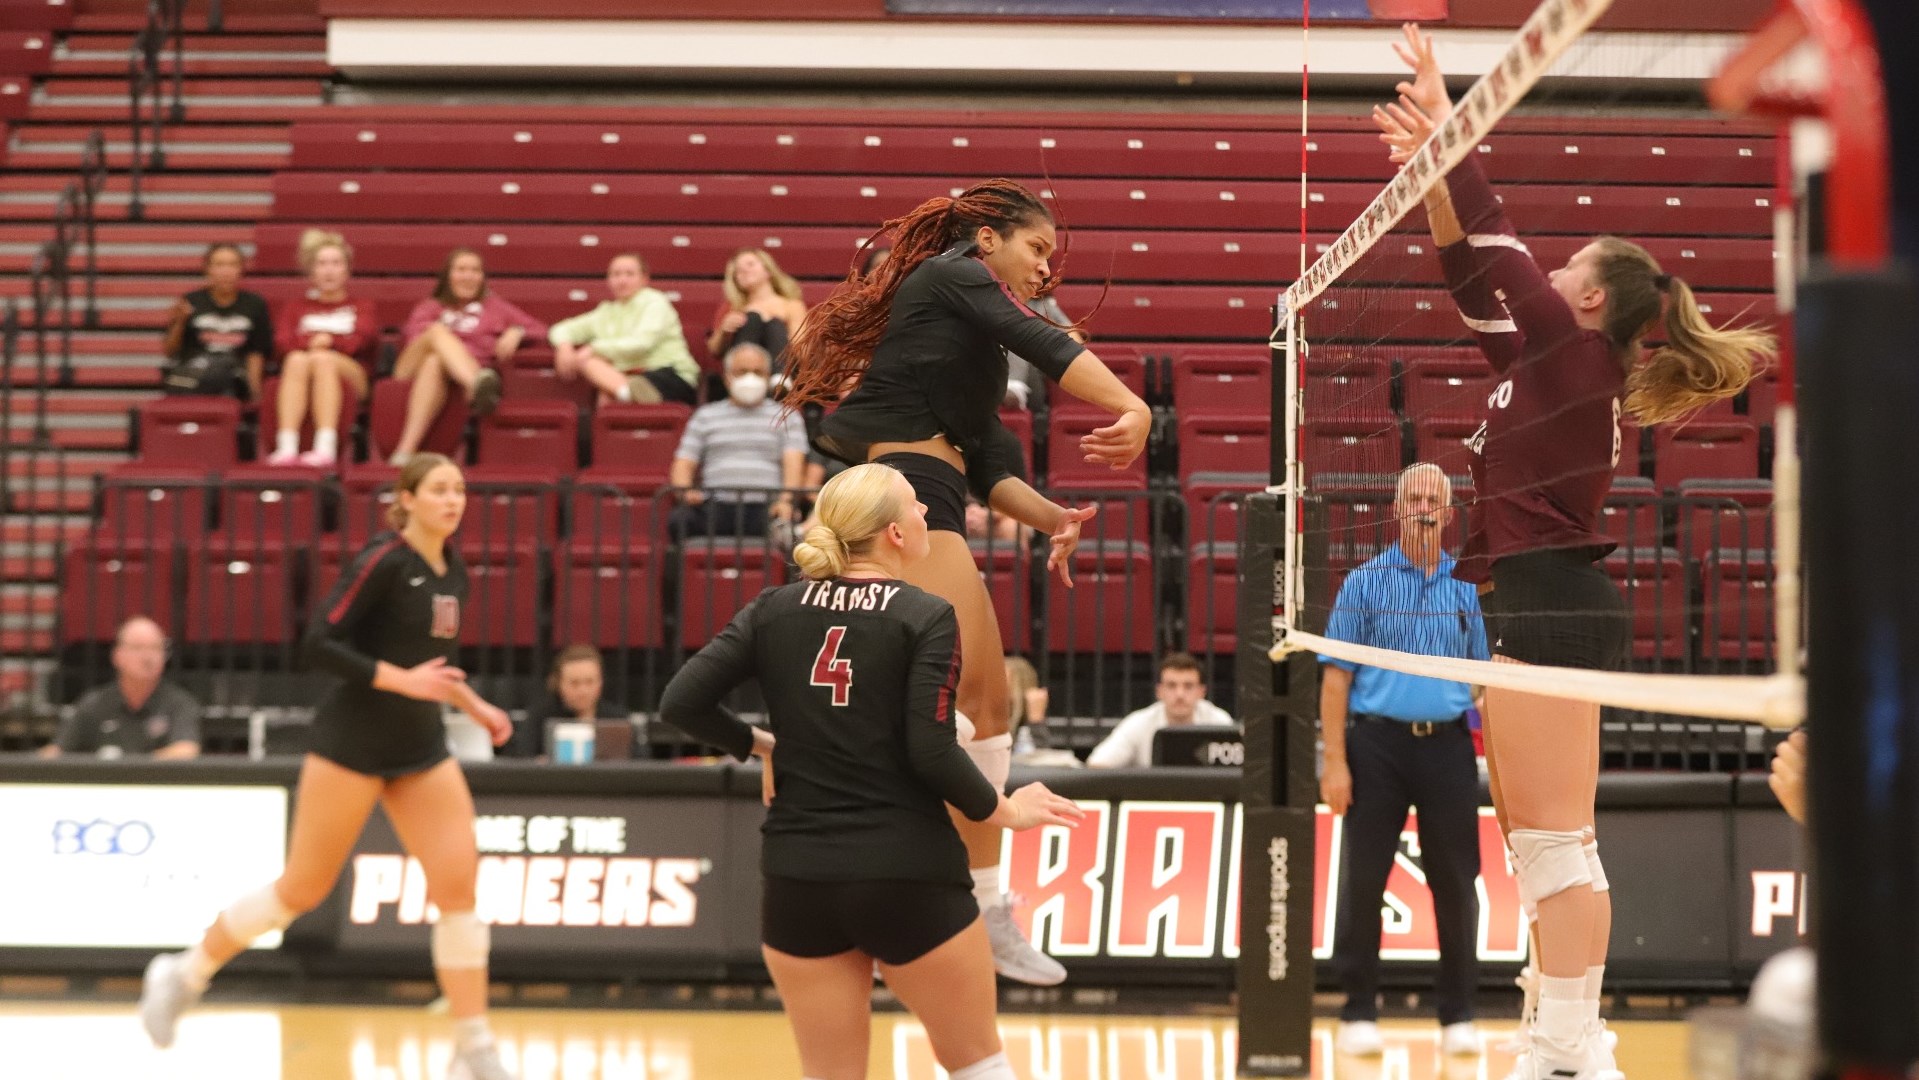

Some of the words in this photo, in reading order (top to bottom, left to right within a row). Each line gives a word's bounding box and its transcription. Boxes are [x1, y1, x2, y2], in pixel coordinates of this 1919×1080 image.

[800, 579, 901, 612] TRANSY
[810, 625, 853, 707] 4
[526, 815, 568, 853] OF
[570, 816, 627, 854] THE
[350, 854, 700, 927] PINEERS
